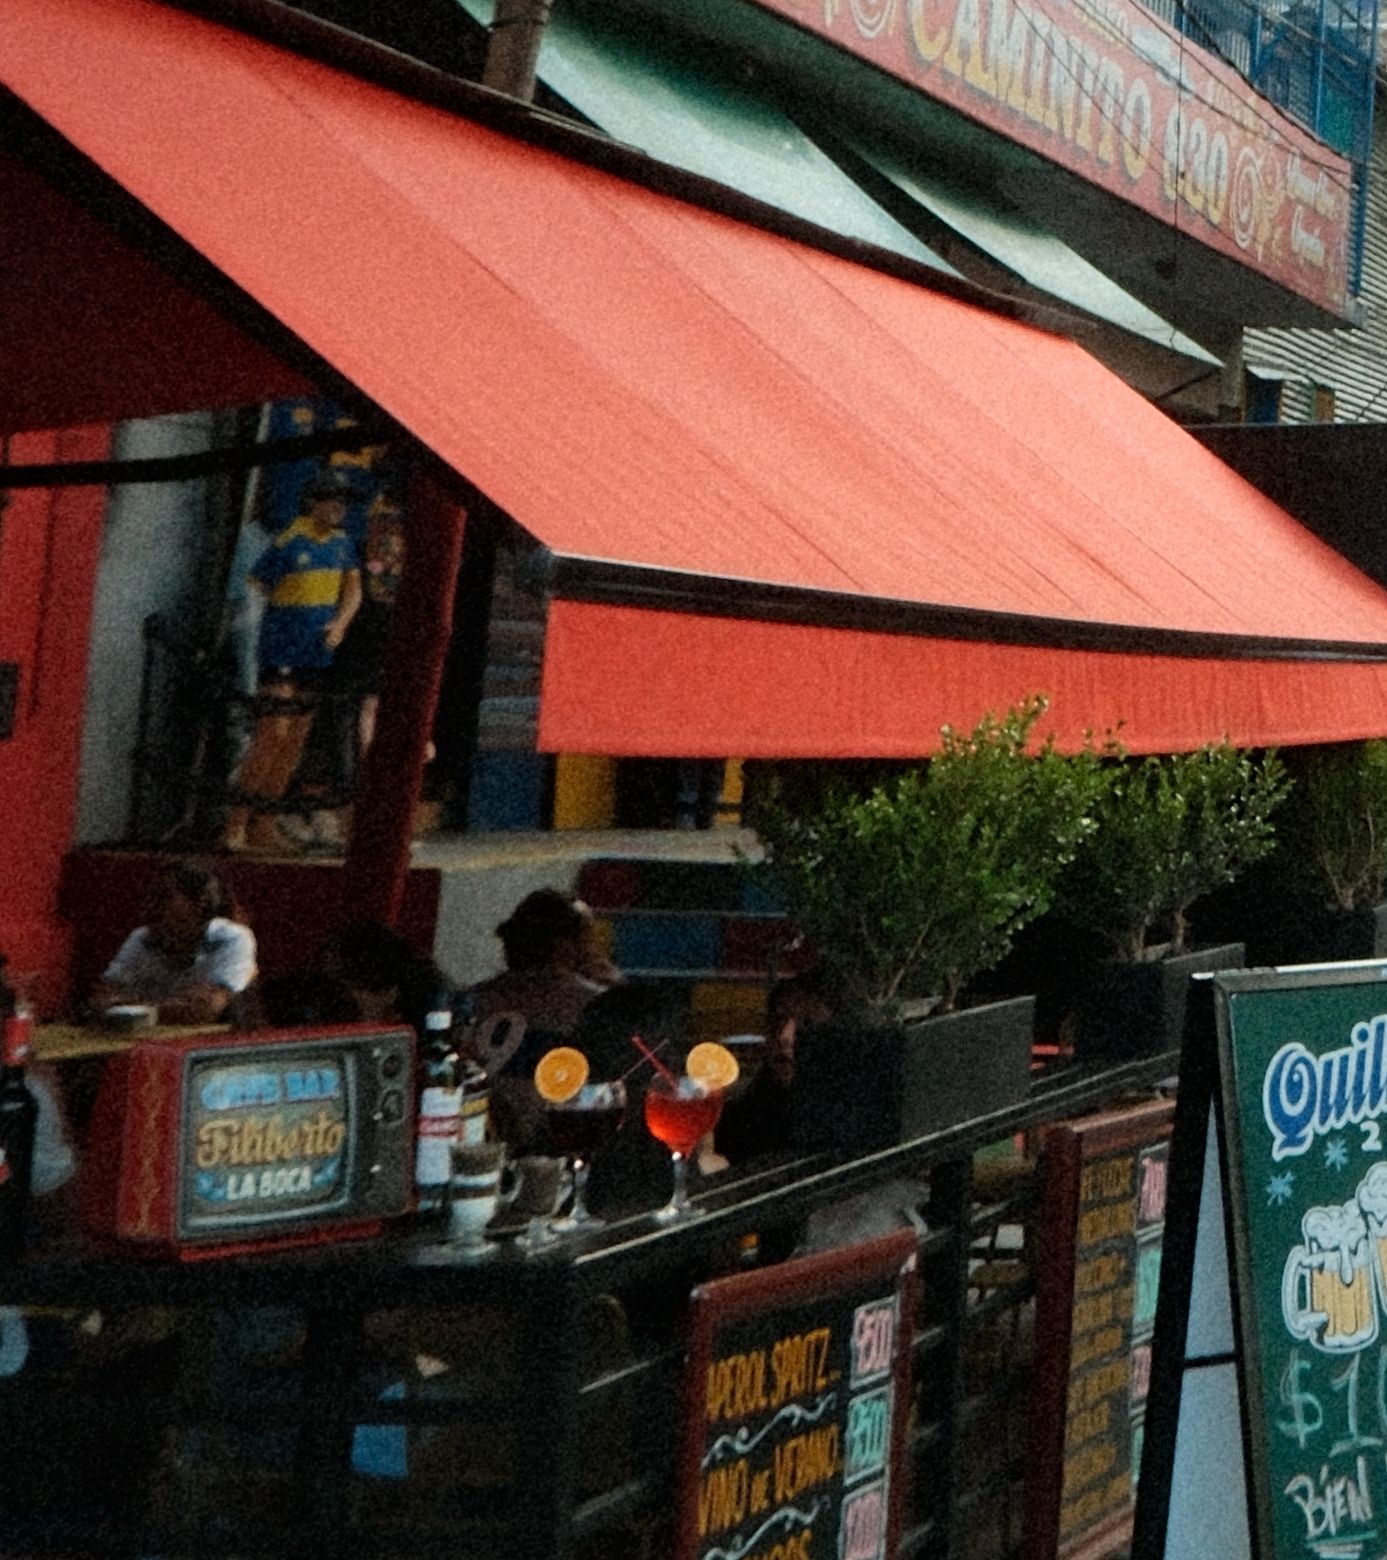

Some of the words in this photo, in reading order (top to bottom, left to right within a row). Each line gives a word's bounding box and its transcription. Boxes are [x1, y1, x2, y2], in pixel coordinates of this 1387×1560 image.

[196, 1111, 345, 1168] Filiberto
[1360, 1123, 1383, 1152] 2
[227, 1173, 256, 1200] LA
[259, 1167, 312, 1196] BOCA
